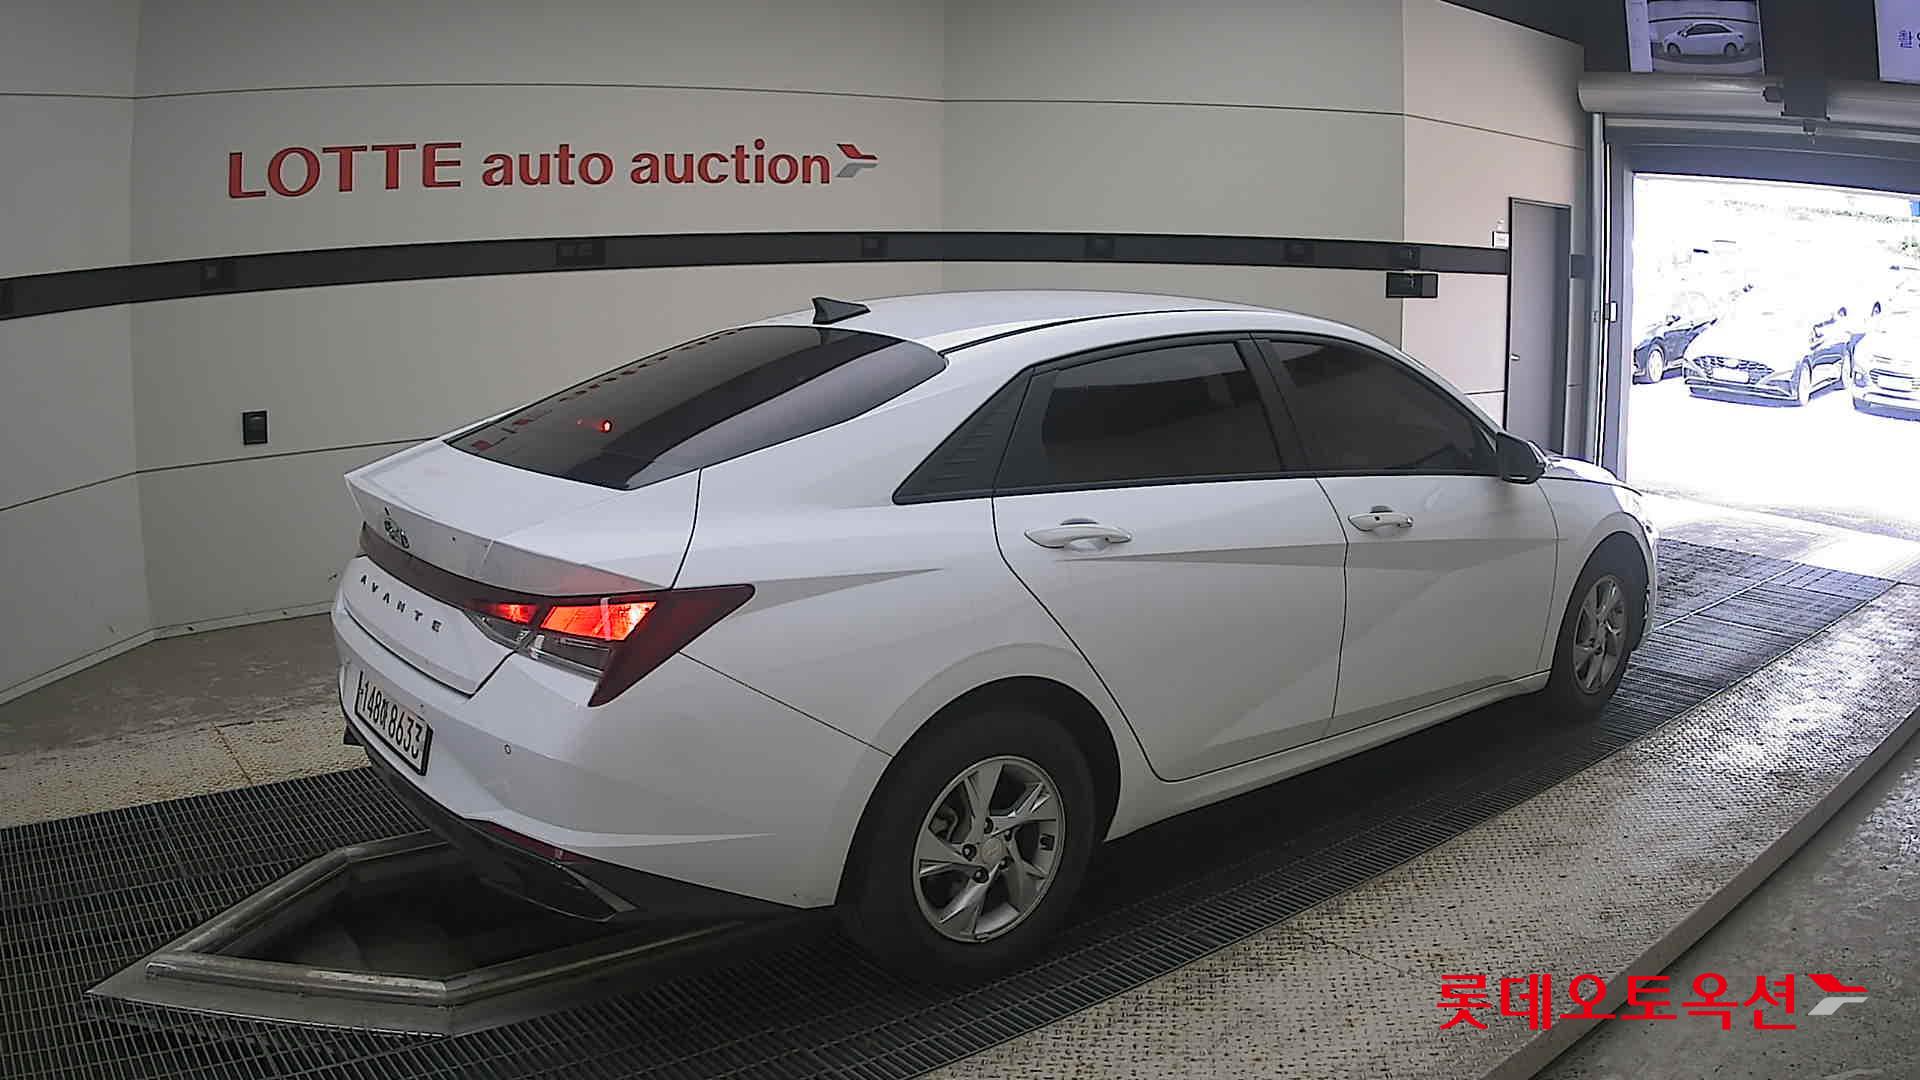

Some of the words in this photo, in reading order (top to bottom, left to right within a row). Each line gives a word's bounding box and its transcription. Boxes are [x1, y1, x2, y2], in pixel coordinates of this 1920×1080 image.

[227, 142, 462, 198] LOTTE
[482, 143, 613, 187] auto
[630, 139, 831, 185] auction
[360, 574, 442, 633] AVANTE
[388, 704, 423, 759] 8633
